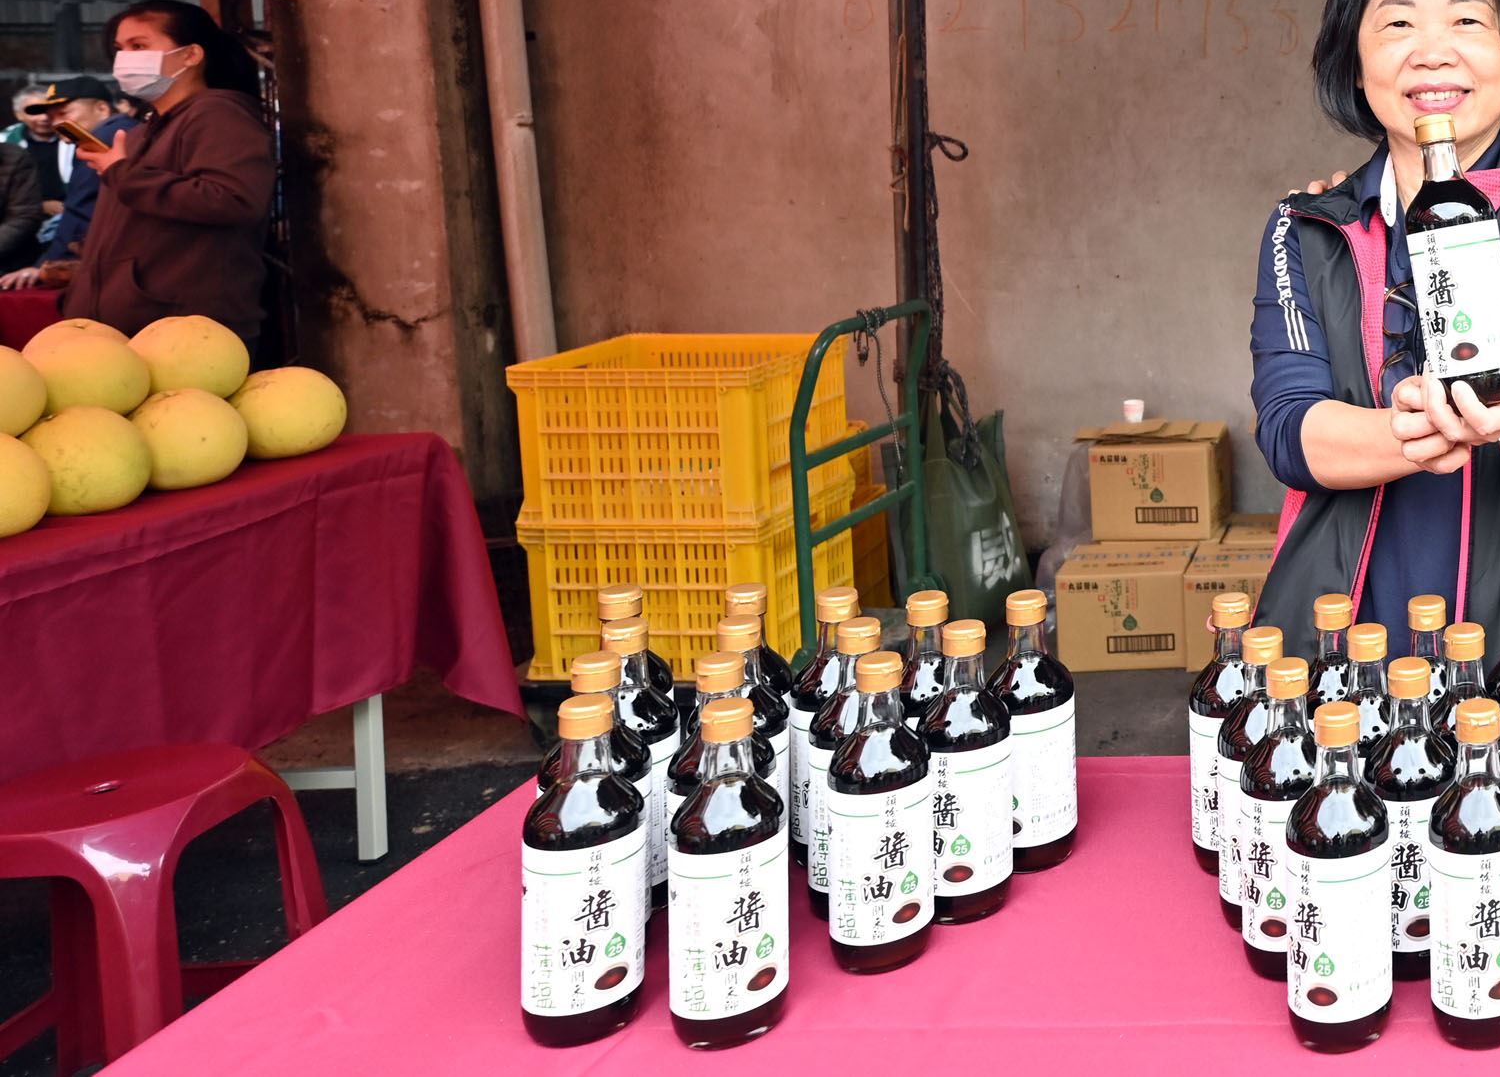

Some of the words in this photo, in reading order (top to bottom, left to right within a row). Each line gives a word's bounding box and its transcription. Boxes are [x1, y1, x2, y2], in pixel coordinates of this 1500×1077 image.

[1426, 270, 1455, 335] 醬油
[1456, 322, 1469, 331] 25
[955, 844, 968, 854] 25
[864, 831, 910, 901] 醬油
[1243, 841, 1275, 905] 醬油
[903, 881, 916, 894] 25
[1269, 898, 1283, 910] 25
[562, 889, 616, 968] 醬油
[714, 890, 764, 969] 醬油
[1290, 903, 1323, 970] 醬油
[607, 944, 624, 957] 25
[759, 945, 773, 958] 25
[1317, 964, 1332, 976] 25
